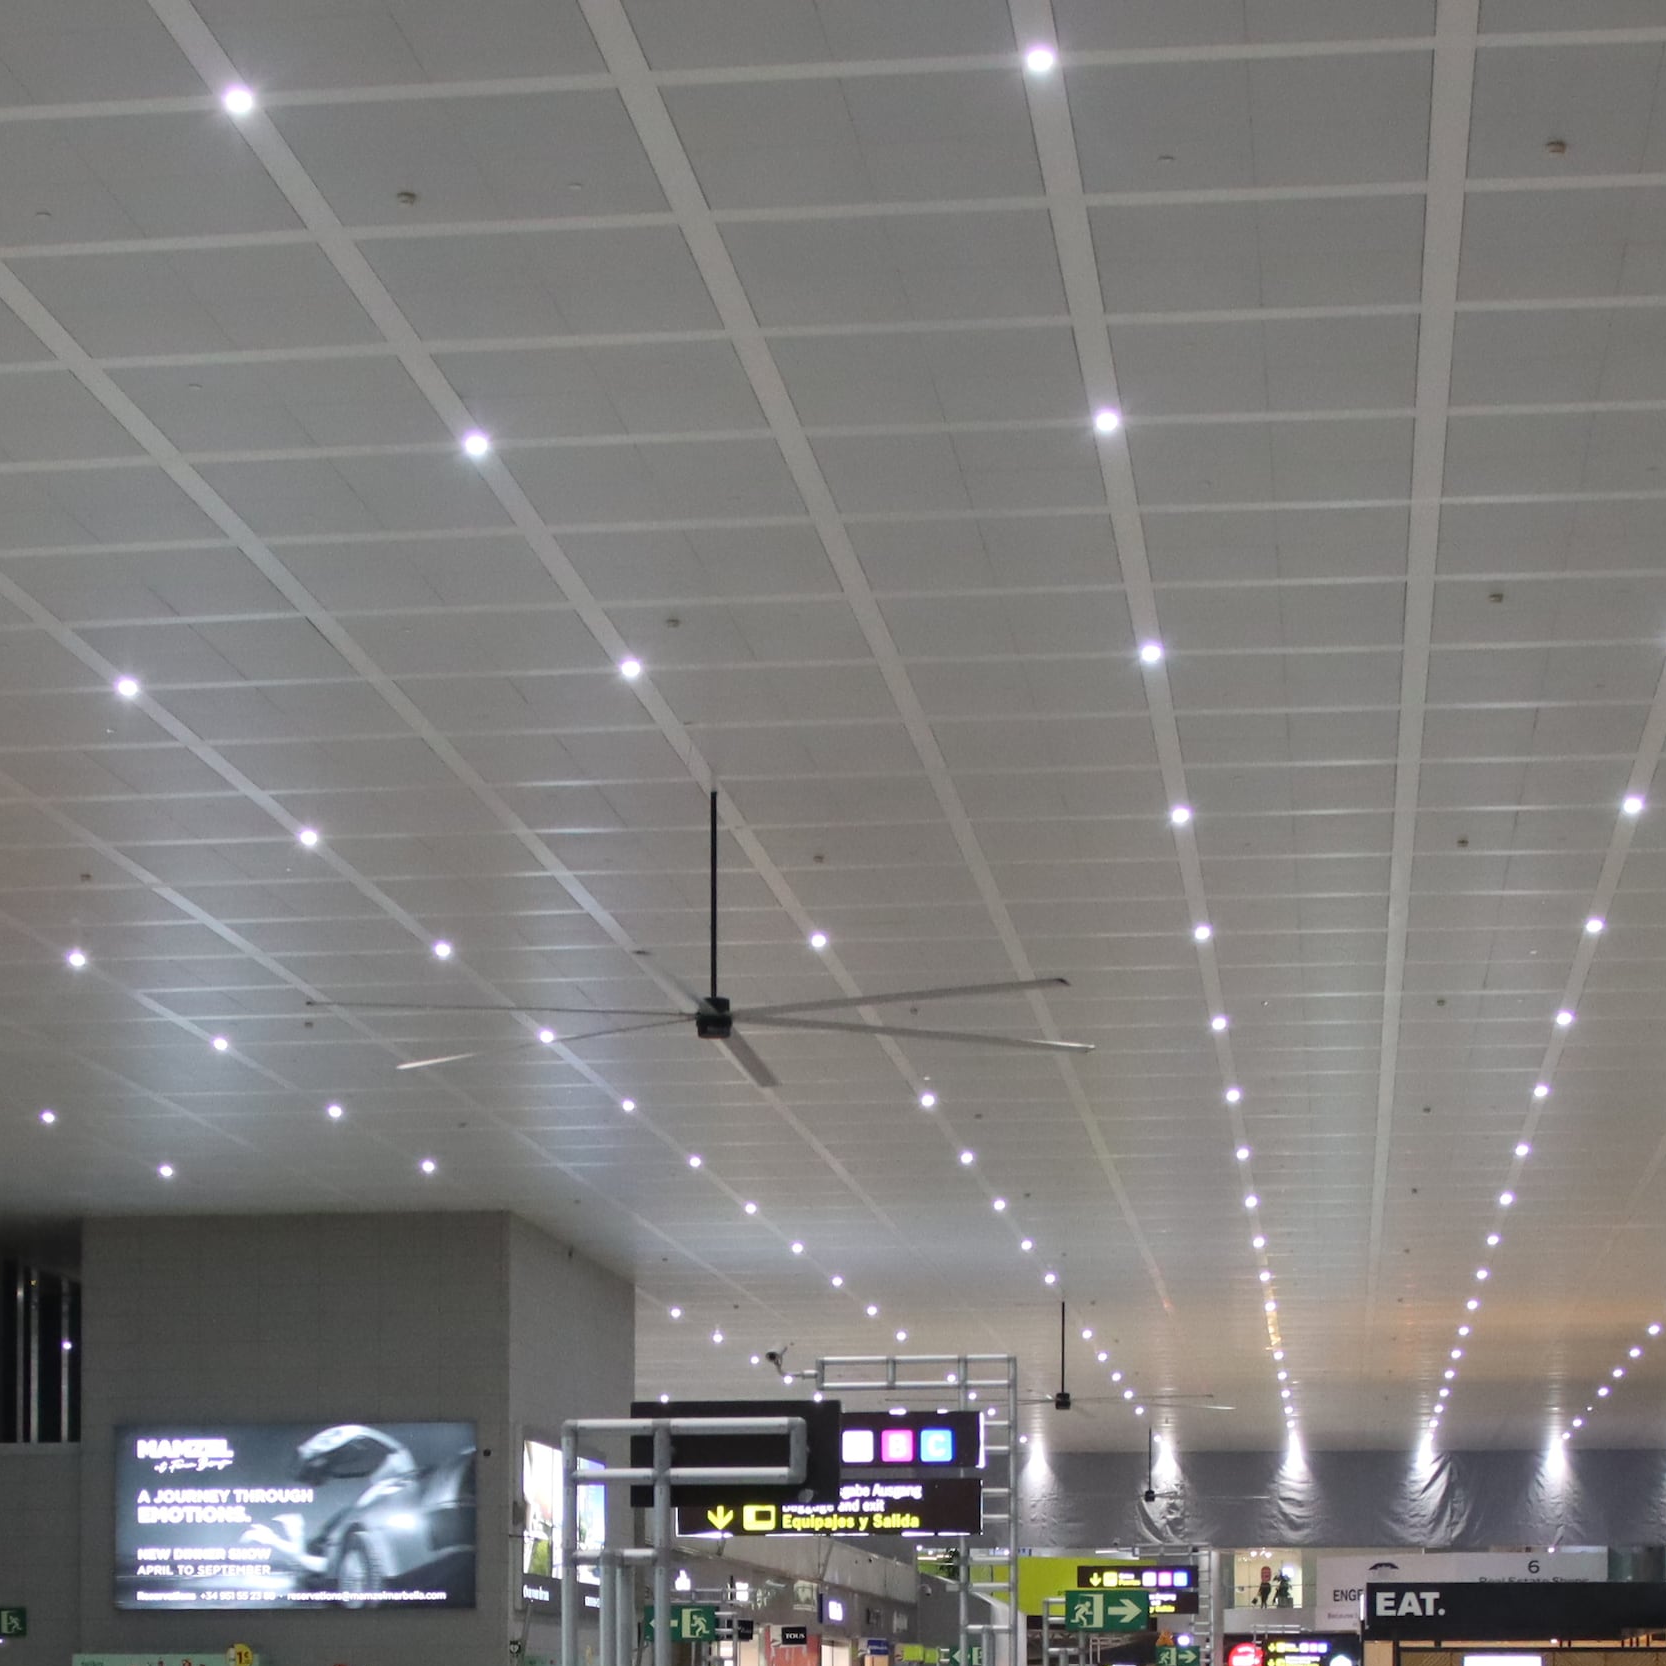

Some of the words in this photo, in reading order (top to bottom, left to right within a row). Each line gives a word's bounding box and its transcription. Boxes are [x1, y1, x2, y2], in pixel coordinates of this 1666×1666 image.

[888, 1433, 908, 1458] B
[927, 1433, 947, 1457] C
[137, 1489, 151, 1504] A
[153, 1489, 231, 1504] JOURNEY
[233, 1489, 314, 1504] THROUGH
[837, 1499, 860, 1512] and
[862, 1499, 885, 1512] exit
[782, 1514, 855, 1531] Equipajes
[858, 1517, 869, 1531] y
[873, 1513, 920, 1528] Salida
[137, 1548, 171, 1561] NEW
[136, 1564, 174, 1576] APRIL
[177, 1564, 195, 1576] TO
[197, 1564, 272, 1576] SEPTEMBER
[1527, 1560, 1541, 1574] 6
[1375, 1591, 1446, 1617] EAT.
